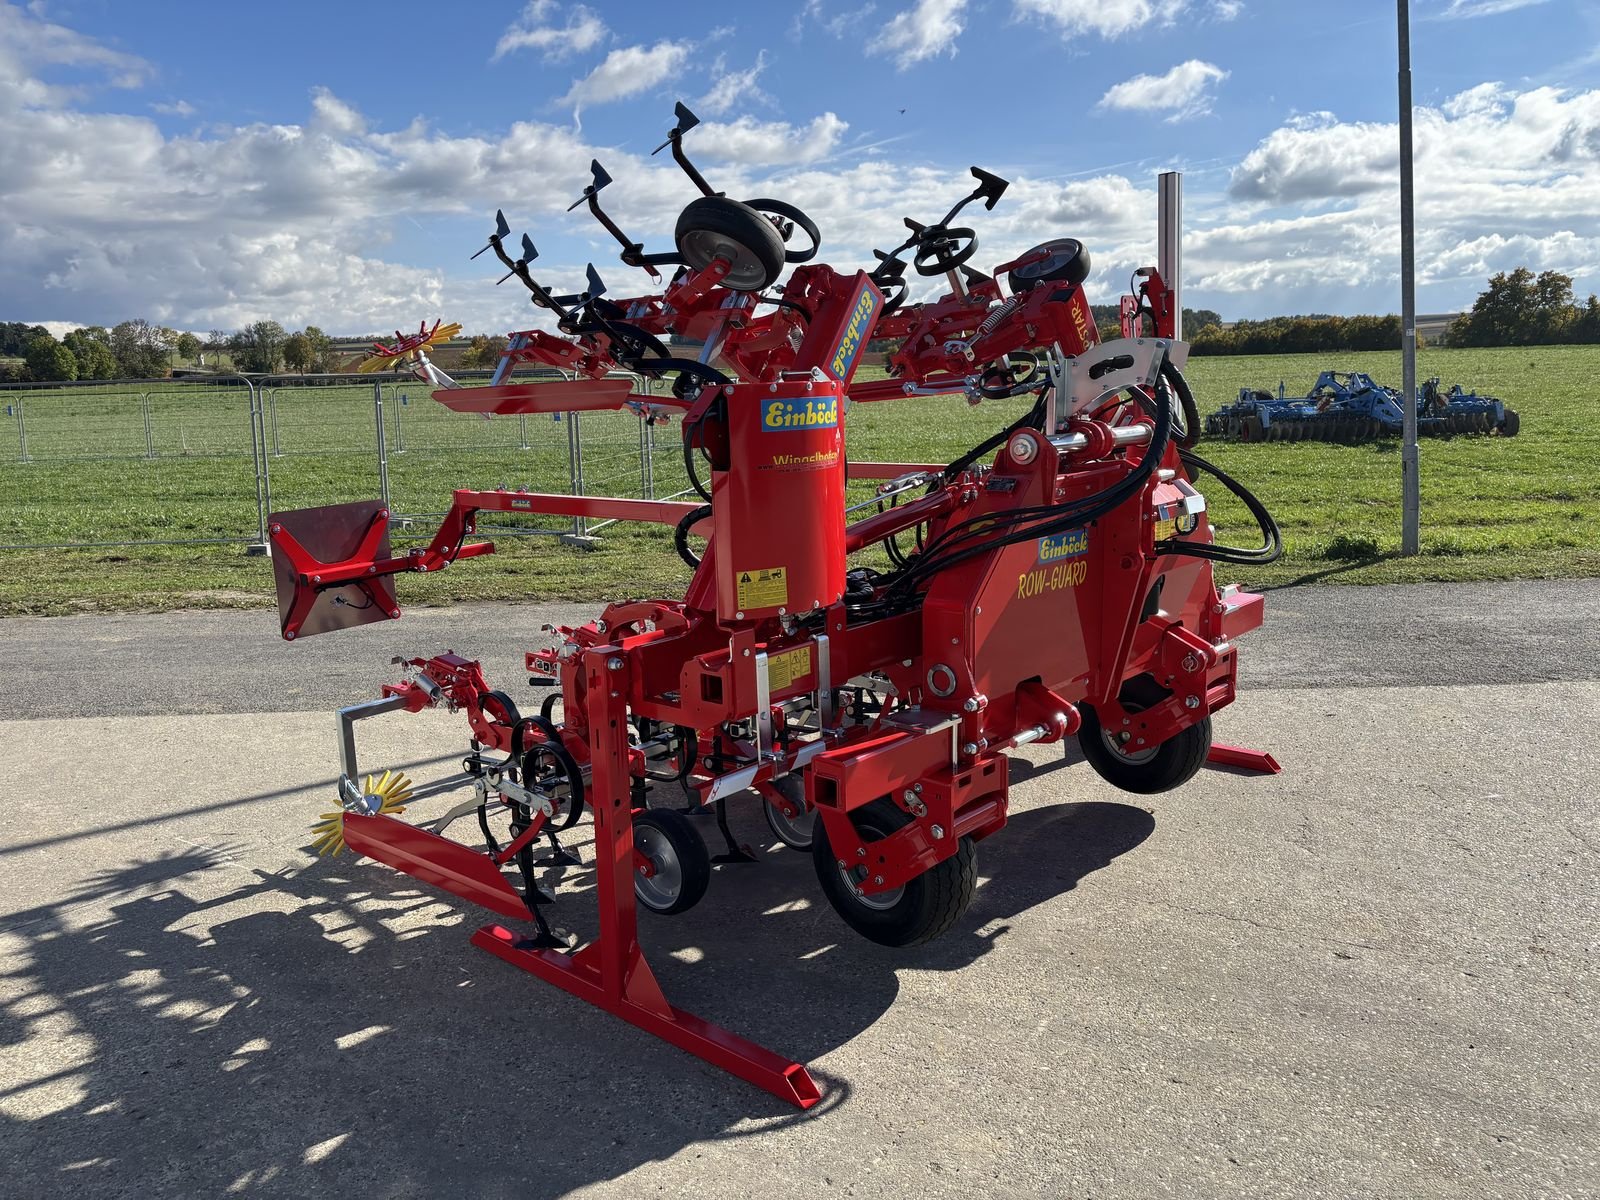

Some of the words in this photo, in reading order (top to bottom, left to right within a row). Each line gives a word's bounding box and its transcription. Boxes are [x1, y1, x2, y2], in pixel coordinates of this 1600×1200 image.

[833, 290, 873, 377] Einböck
[765, 400, 837, 427] Einböck
[1040, 532, 1088, 560] Einböck
[1017, 560, 1087, 599] ROW-GUARD
